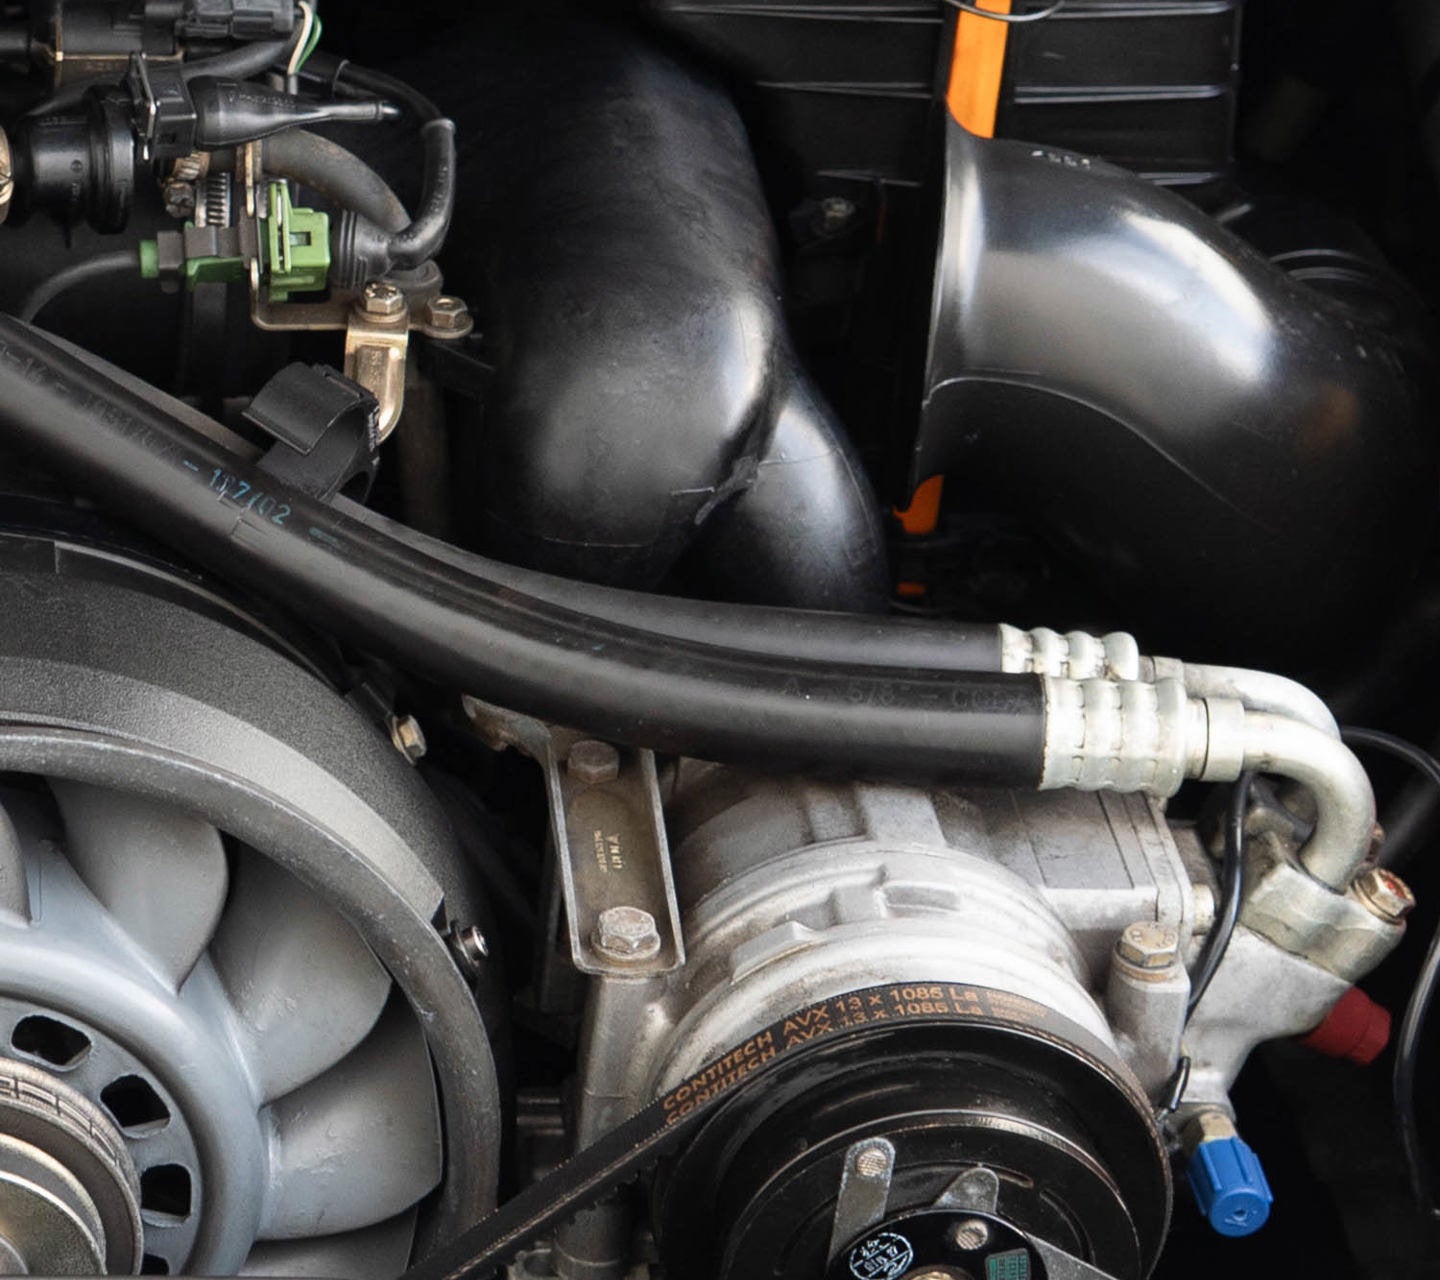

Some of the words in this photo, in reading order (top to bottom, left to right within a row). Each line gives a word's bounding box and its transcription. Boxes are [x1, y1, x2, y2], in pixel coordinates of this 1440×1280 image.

[663, 1032, 774, 1111] CONTITECH
[781, 1005, 829, 1036] AVX
[835, 996, 863, 1013] 13
[665, 1046, 777, 1126] CONTITECH
